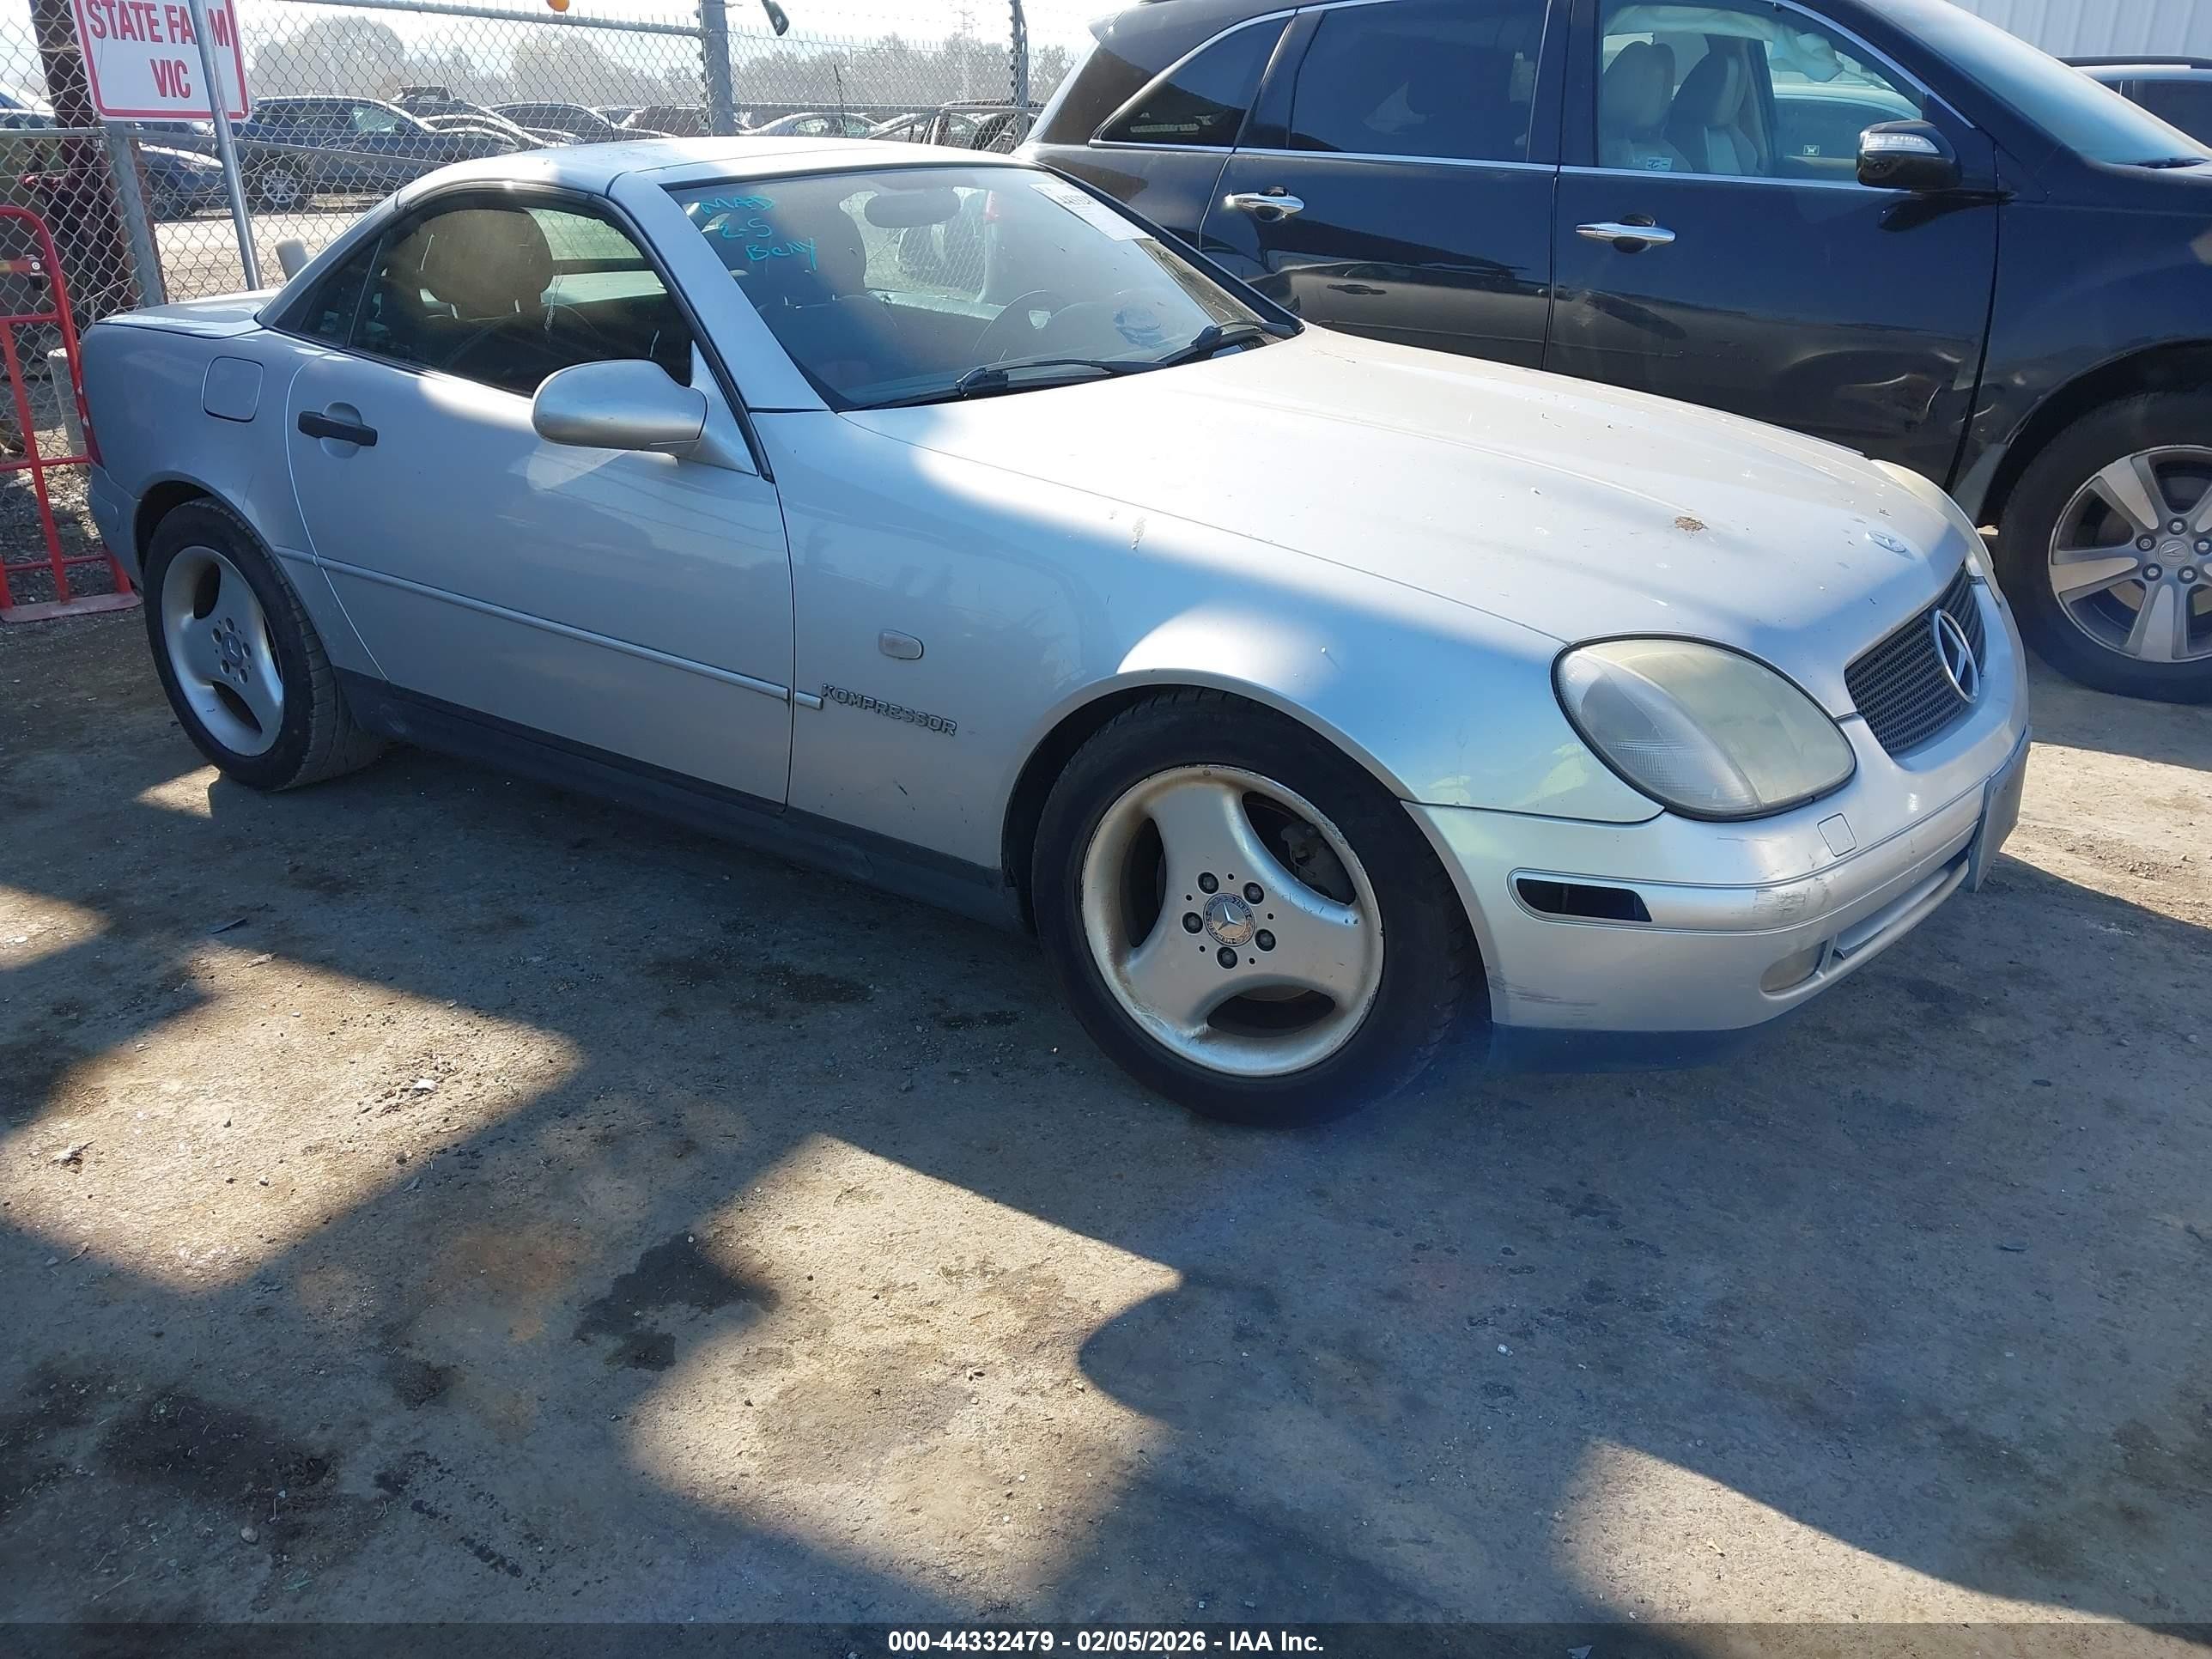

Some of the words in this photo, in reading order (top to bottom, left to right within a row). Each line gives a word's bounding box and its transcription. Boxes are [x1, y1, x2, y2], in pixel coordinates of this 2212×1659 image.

[86, 0, 163, 42] STATE
[164, 4, 229, 46] FAM
[149, 58, 191, 98] VIC
[822, 684, 957, 737] KOMPRESSOR
